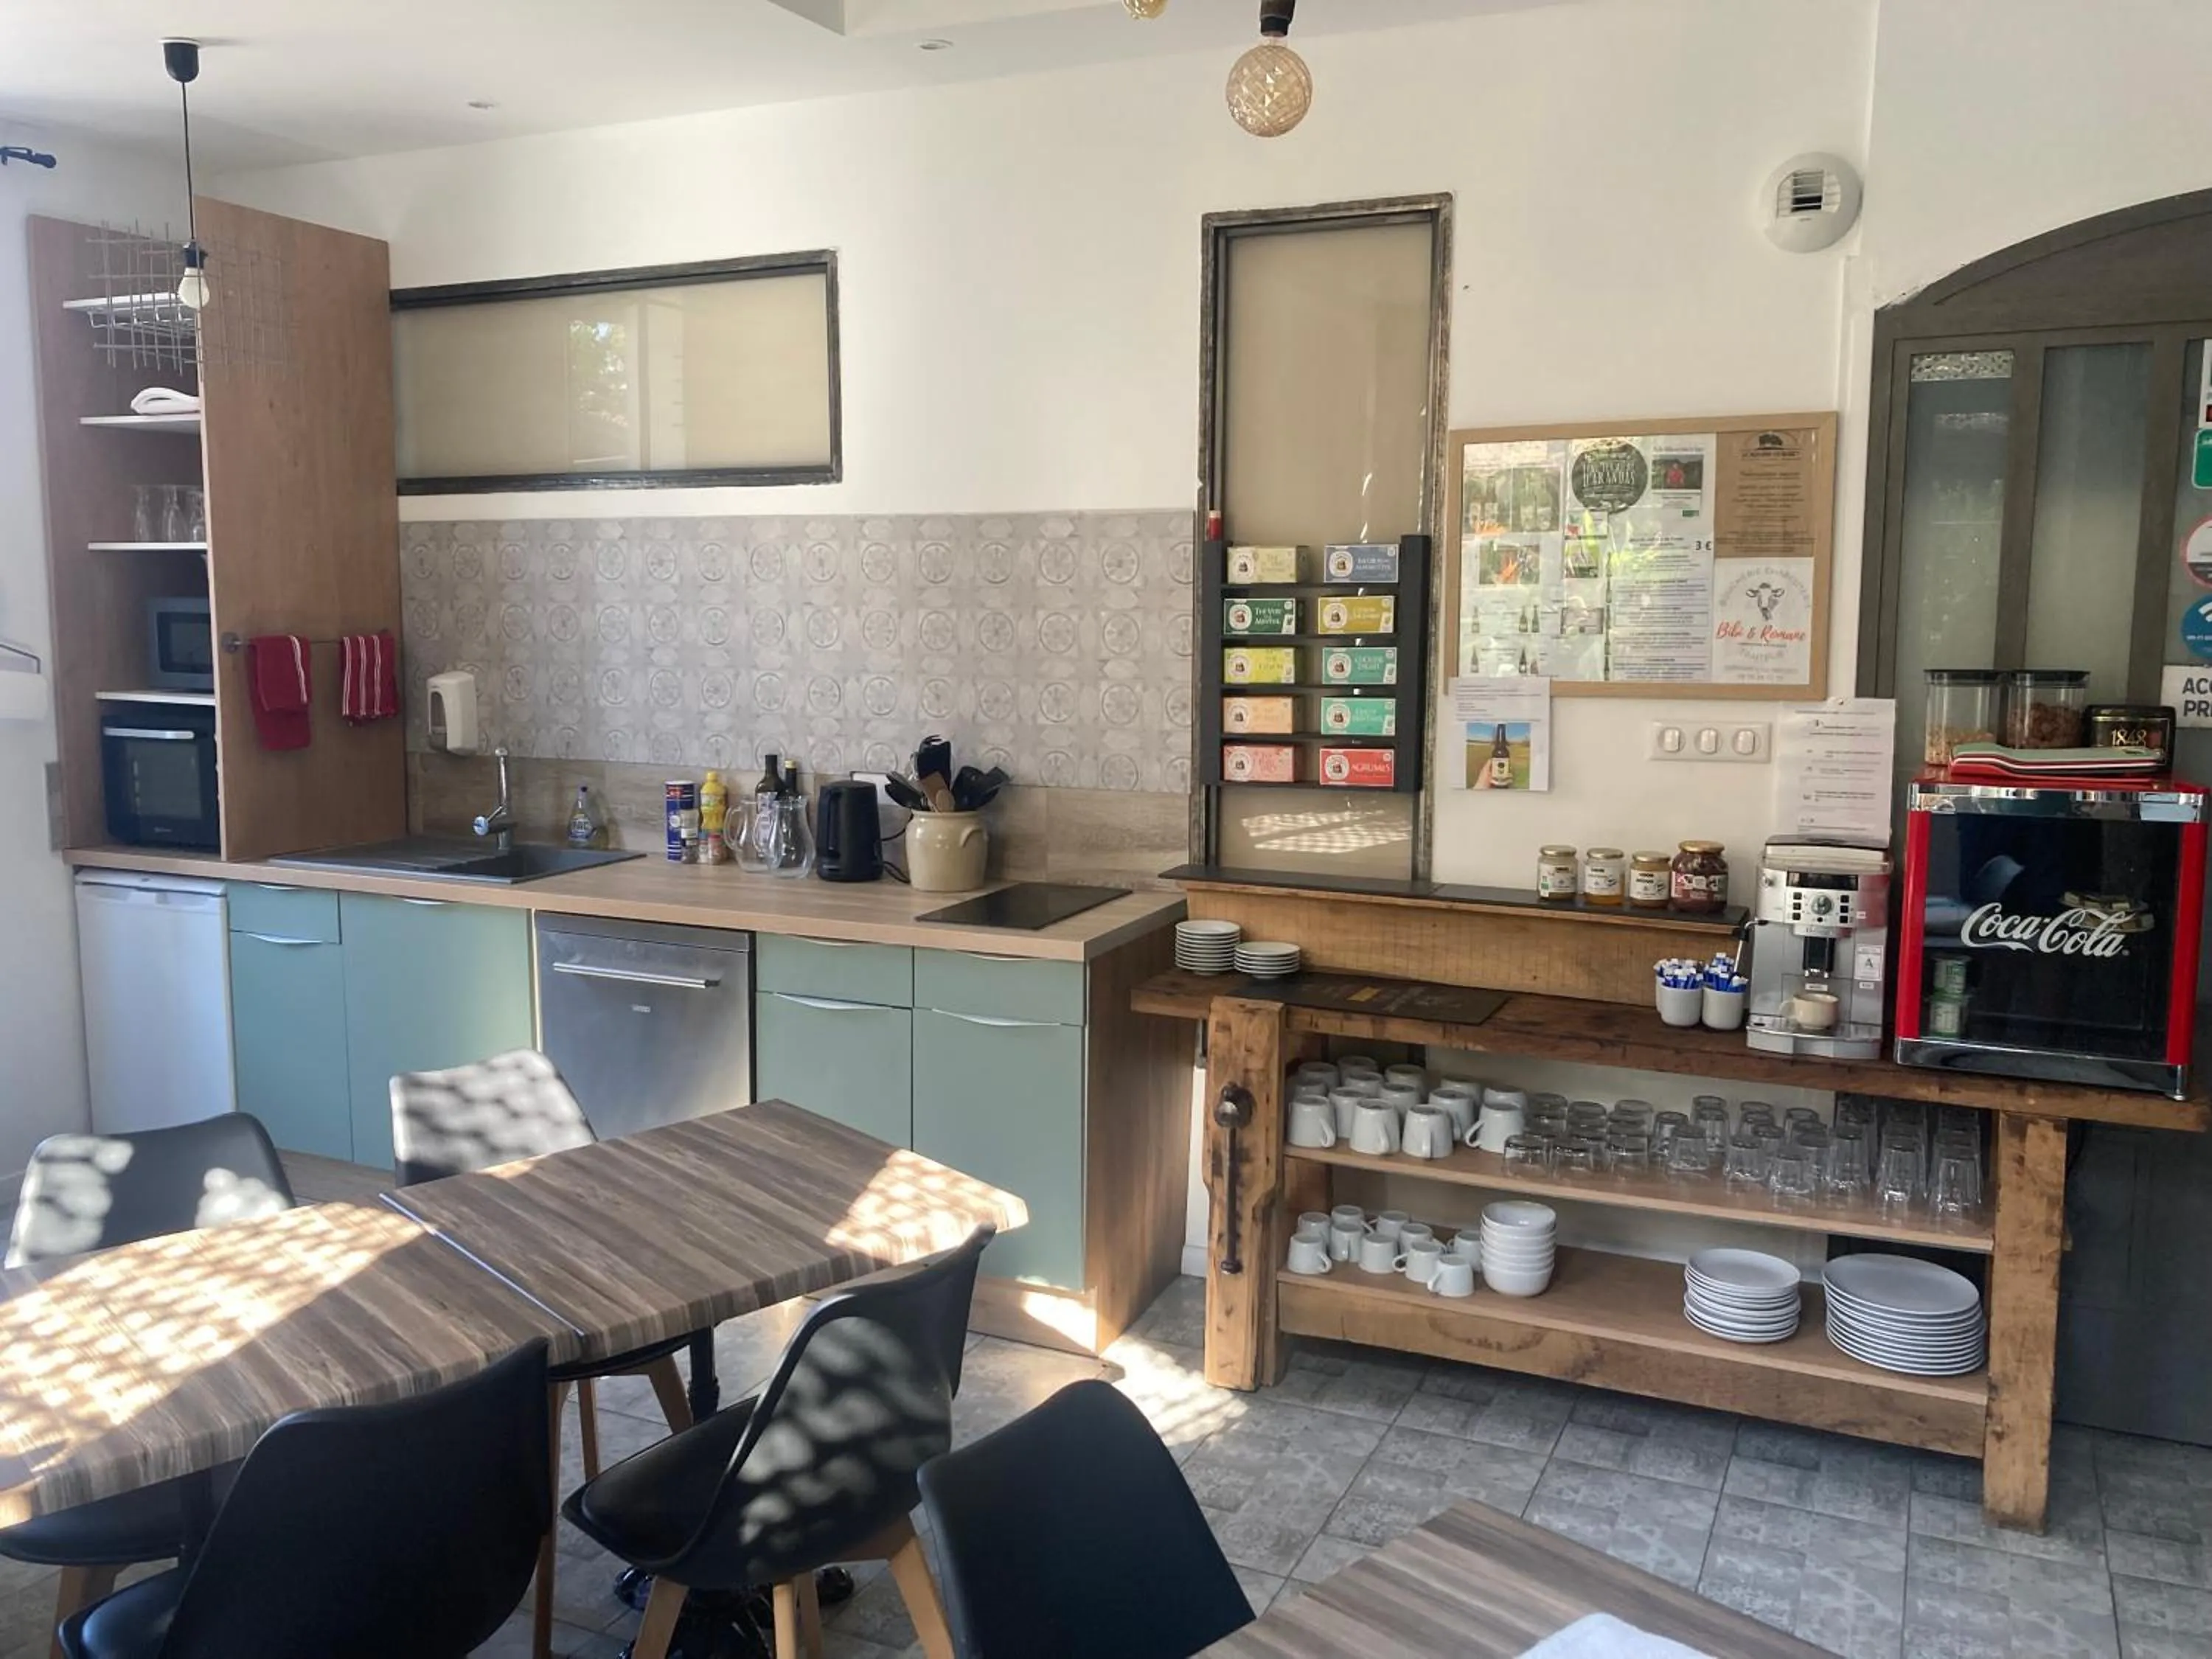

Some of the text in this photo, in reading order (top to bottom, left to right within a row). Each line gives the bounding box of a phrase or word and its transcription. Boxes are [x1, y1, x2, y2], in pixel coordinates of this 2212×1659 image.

[1695, 540, 1711, 551] 3 €
[2183, 700, 2212, 717] PR
[1961, 902, 2132, 958] Coca-Cola
